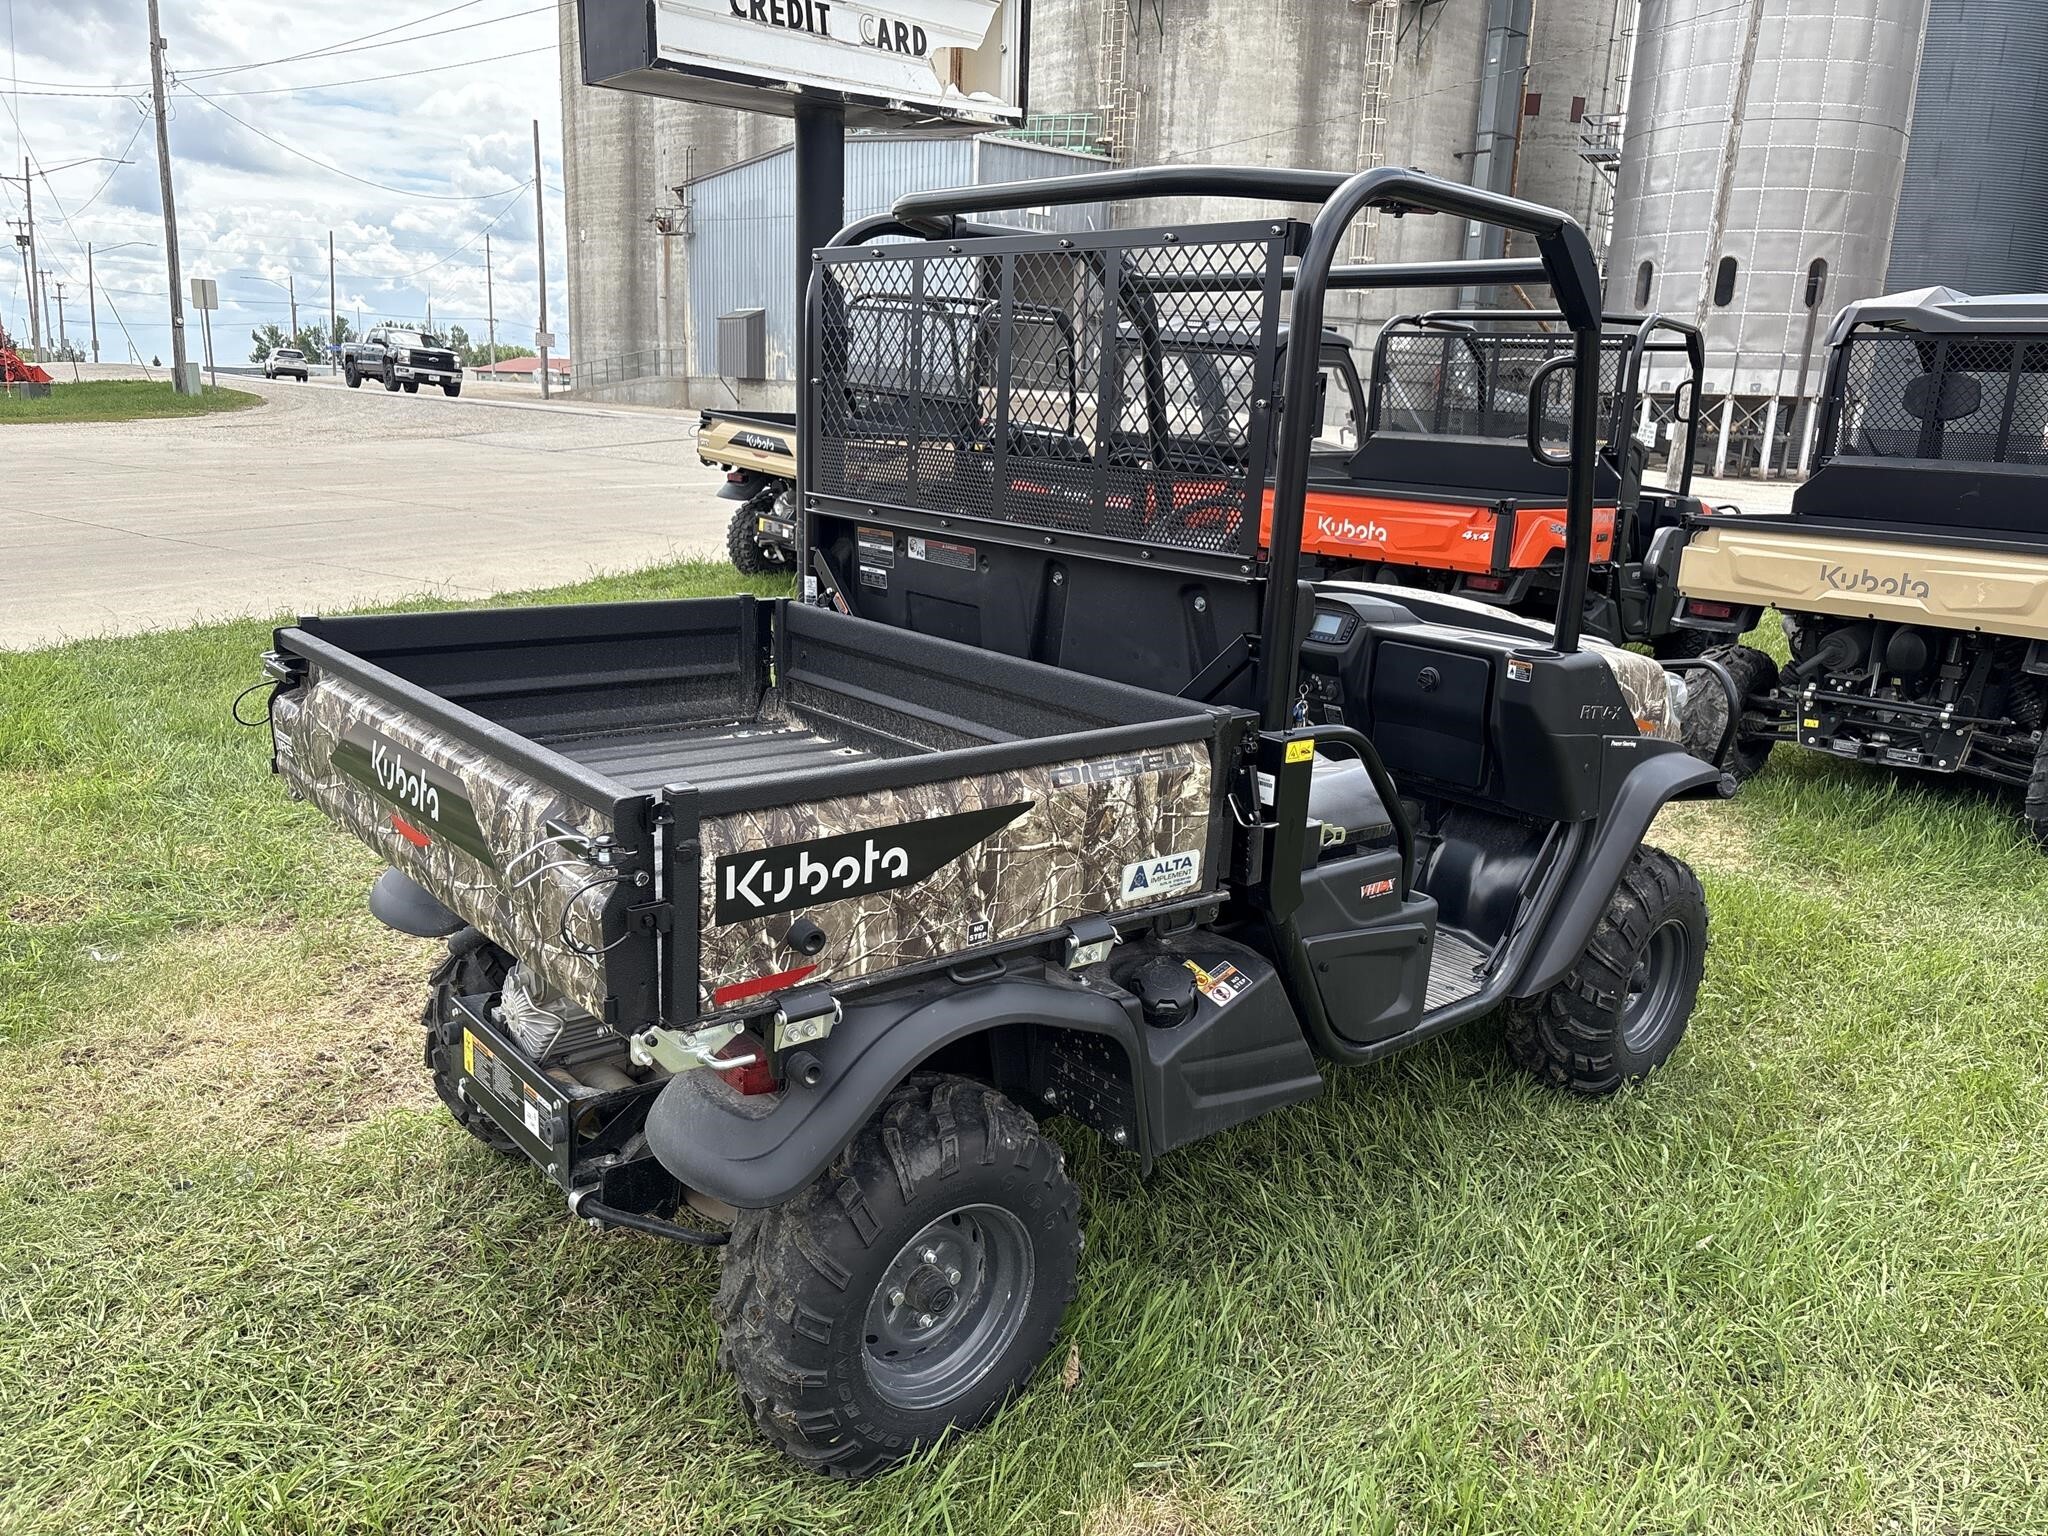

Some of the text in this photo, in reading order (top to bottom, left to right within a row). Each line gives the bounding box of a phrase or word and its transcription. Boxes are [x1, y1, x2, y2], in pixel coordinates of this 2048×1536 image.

[730, 0, 927, 56] CREDIT CARD
[746, 434, 775, 451] Kubota
[1317, 515, 1387, 542] Kubota
[1461, 529, 1491, 542] 4x4
[1819, 564, 1930, 599] Kubota
[371, 739, 439, 822] Kubota
[726, 839, 909, 907] Kubota
[1152, 856, 1192, 875] ALTA
[1150, 868, 1192, 884] IMPLEMENT
[969, 931, 987, 941] STEP
[974, 924, 985, 933] NO
[1231, 976, 1240, 984] NO
[1233, 978, 1246, 989] STEP
